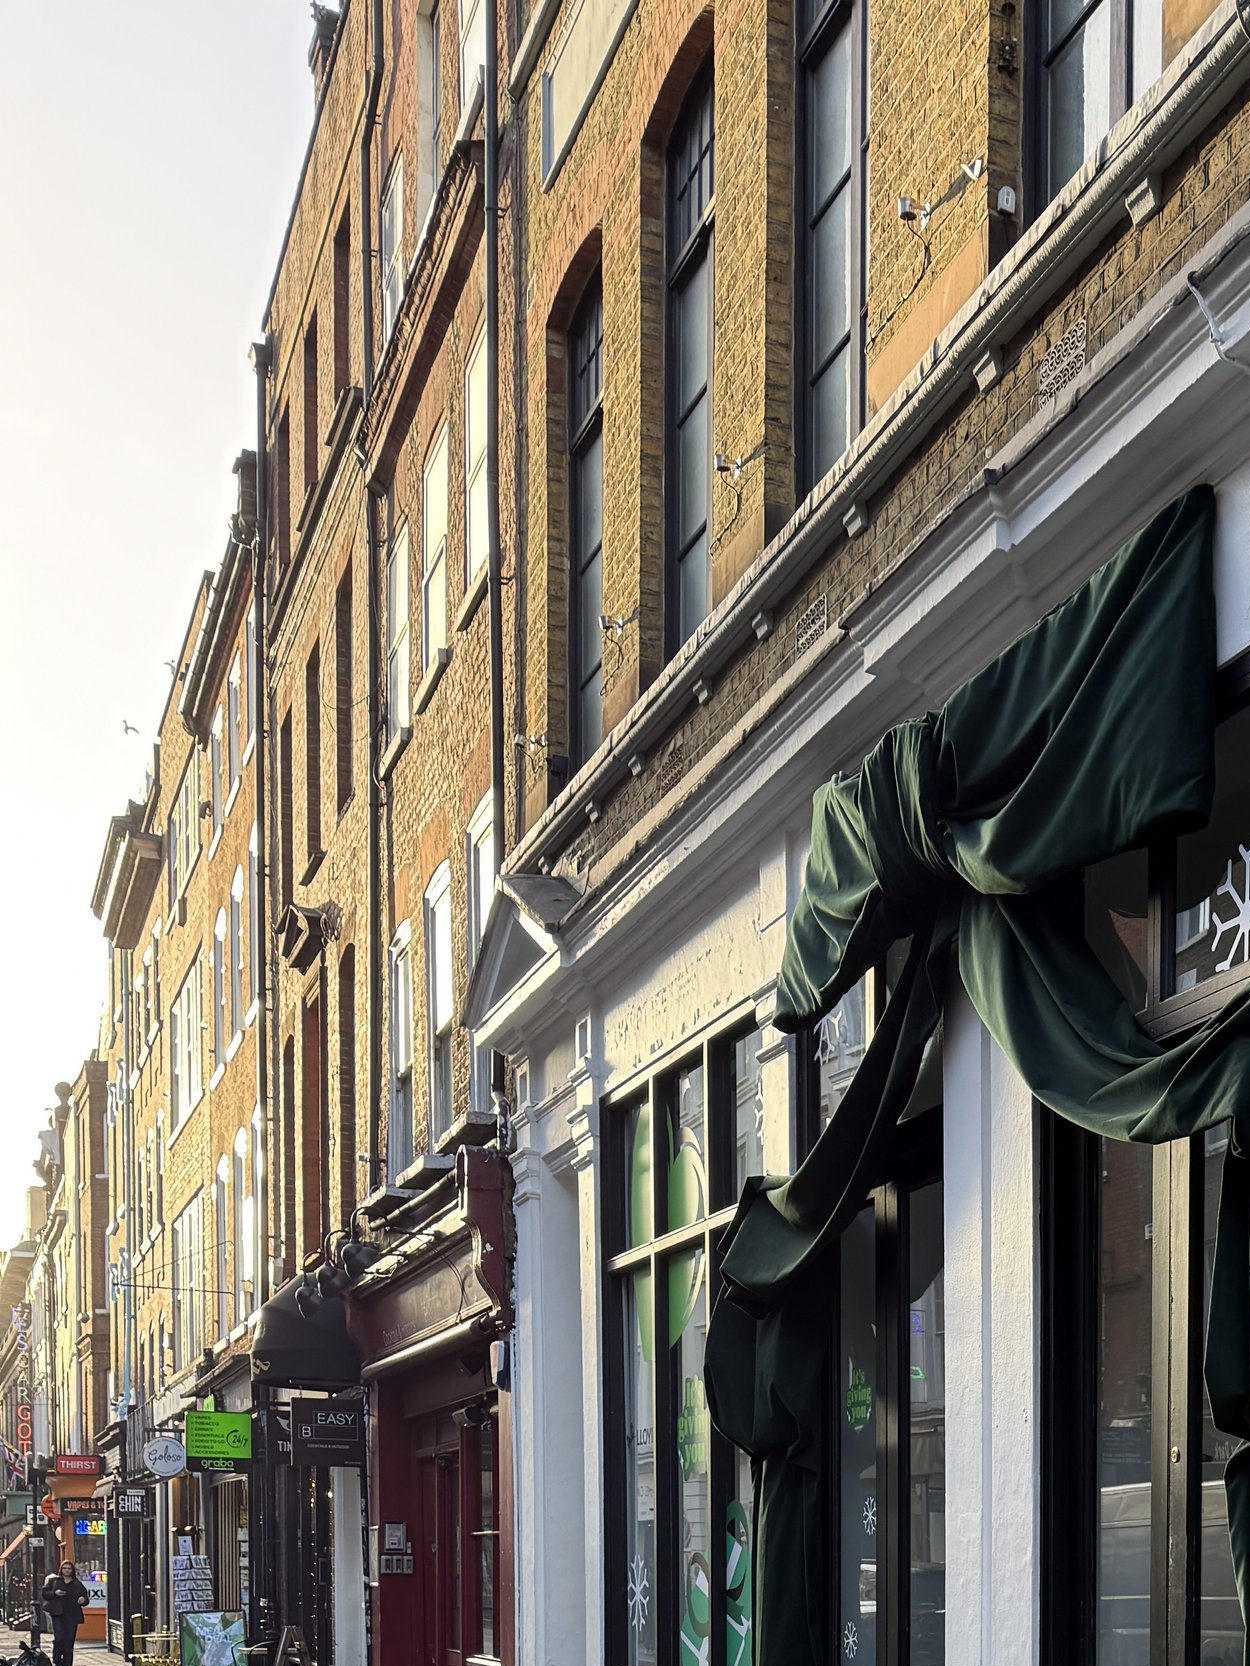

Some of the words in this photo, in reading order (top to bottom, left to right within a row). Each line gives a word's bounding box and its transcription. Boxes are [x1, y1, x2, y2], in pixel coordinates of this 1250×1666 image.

[847, 1385, 871, 1407] giving
[317, 1412, 355, 1425] EASY
[852, 1406, 867, 1424] you
[301, 1425, 312, 1438] B
[678, 1410, 709, 1442] givin
[232, 1434, 248, 1447] 24/7
[148, 1445, 182, 1466] Goloso
[684, 1442, 705, 1471] you
[60, 1460, 97, 1470] THIRST
[201, 1458, 234, 1469] grabo
